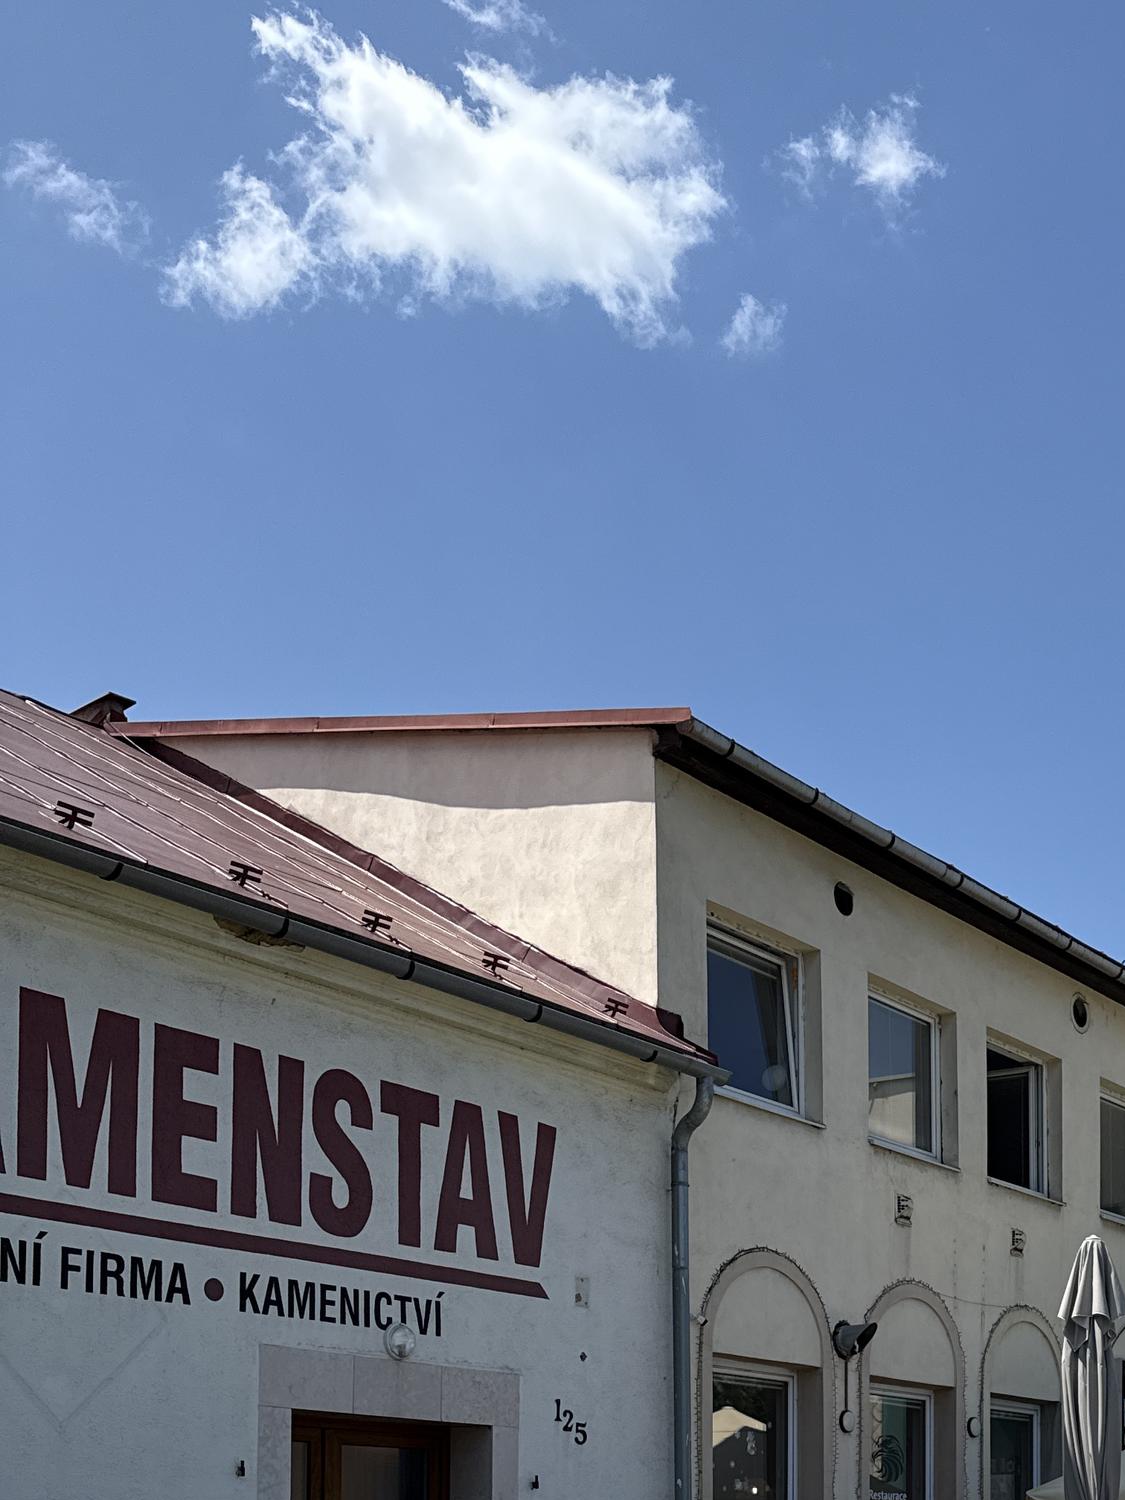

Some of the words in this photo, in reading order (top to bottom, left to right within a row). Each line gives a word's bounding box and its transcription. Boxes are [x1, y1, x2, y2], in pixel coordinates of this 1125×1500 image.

[0, 986, 557, 1268] MENSTAV
[60, 1245, 191, 1306] FIRMA
[238, 1271, 446, 1338] KAMENICTVÍ
[553, 1398, 588, 1445] 125
